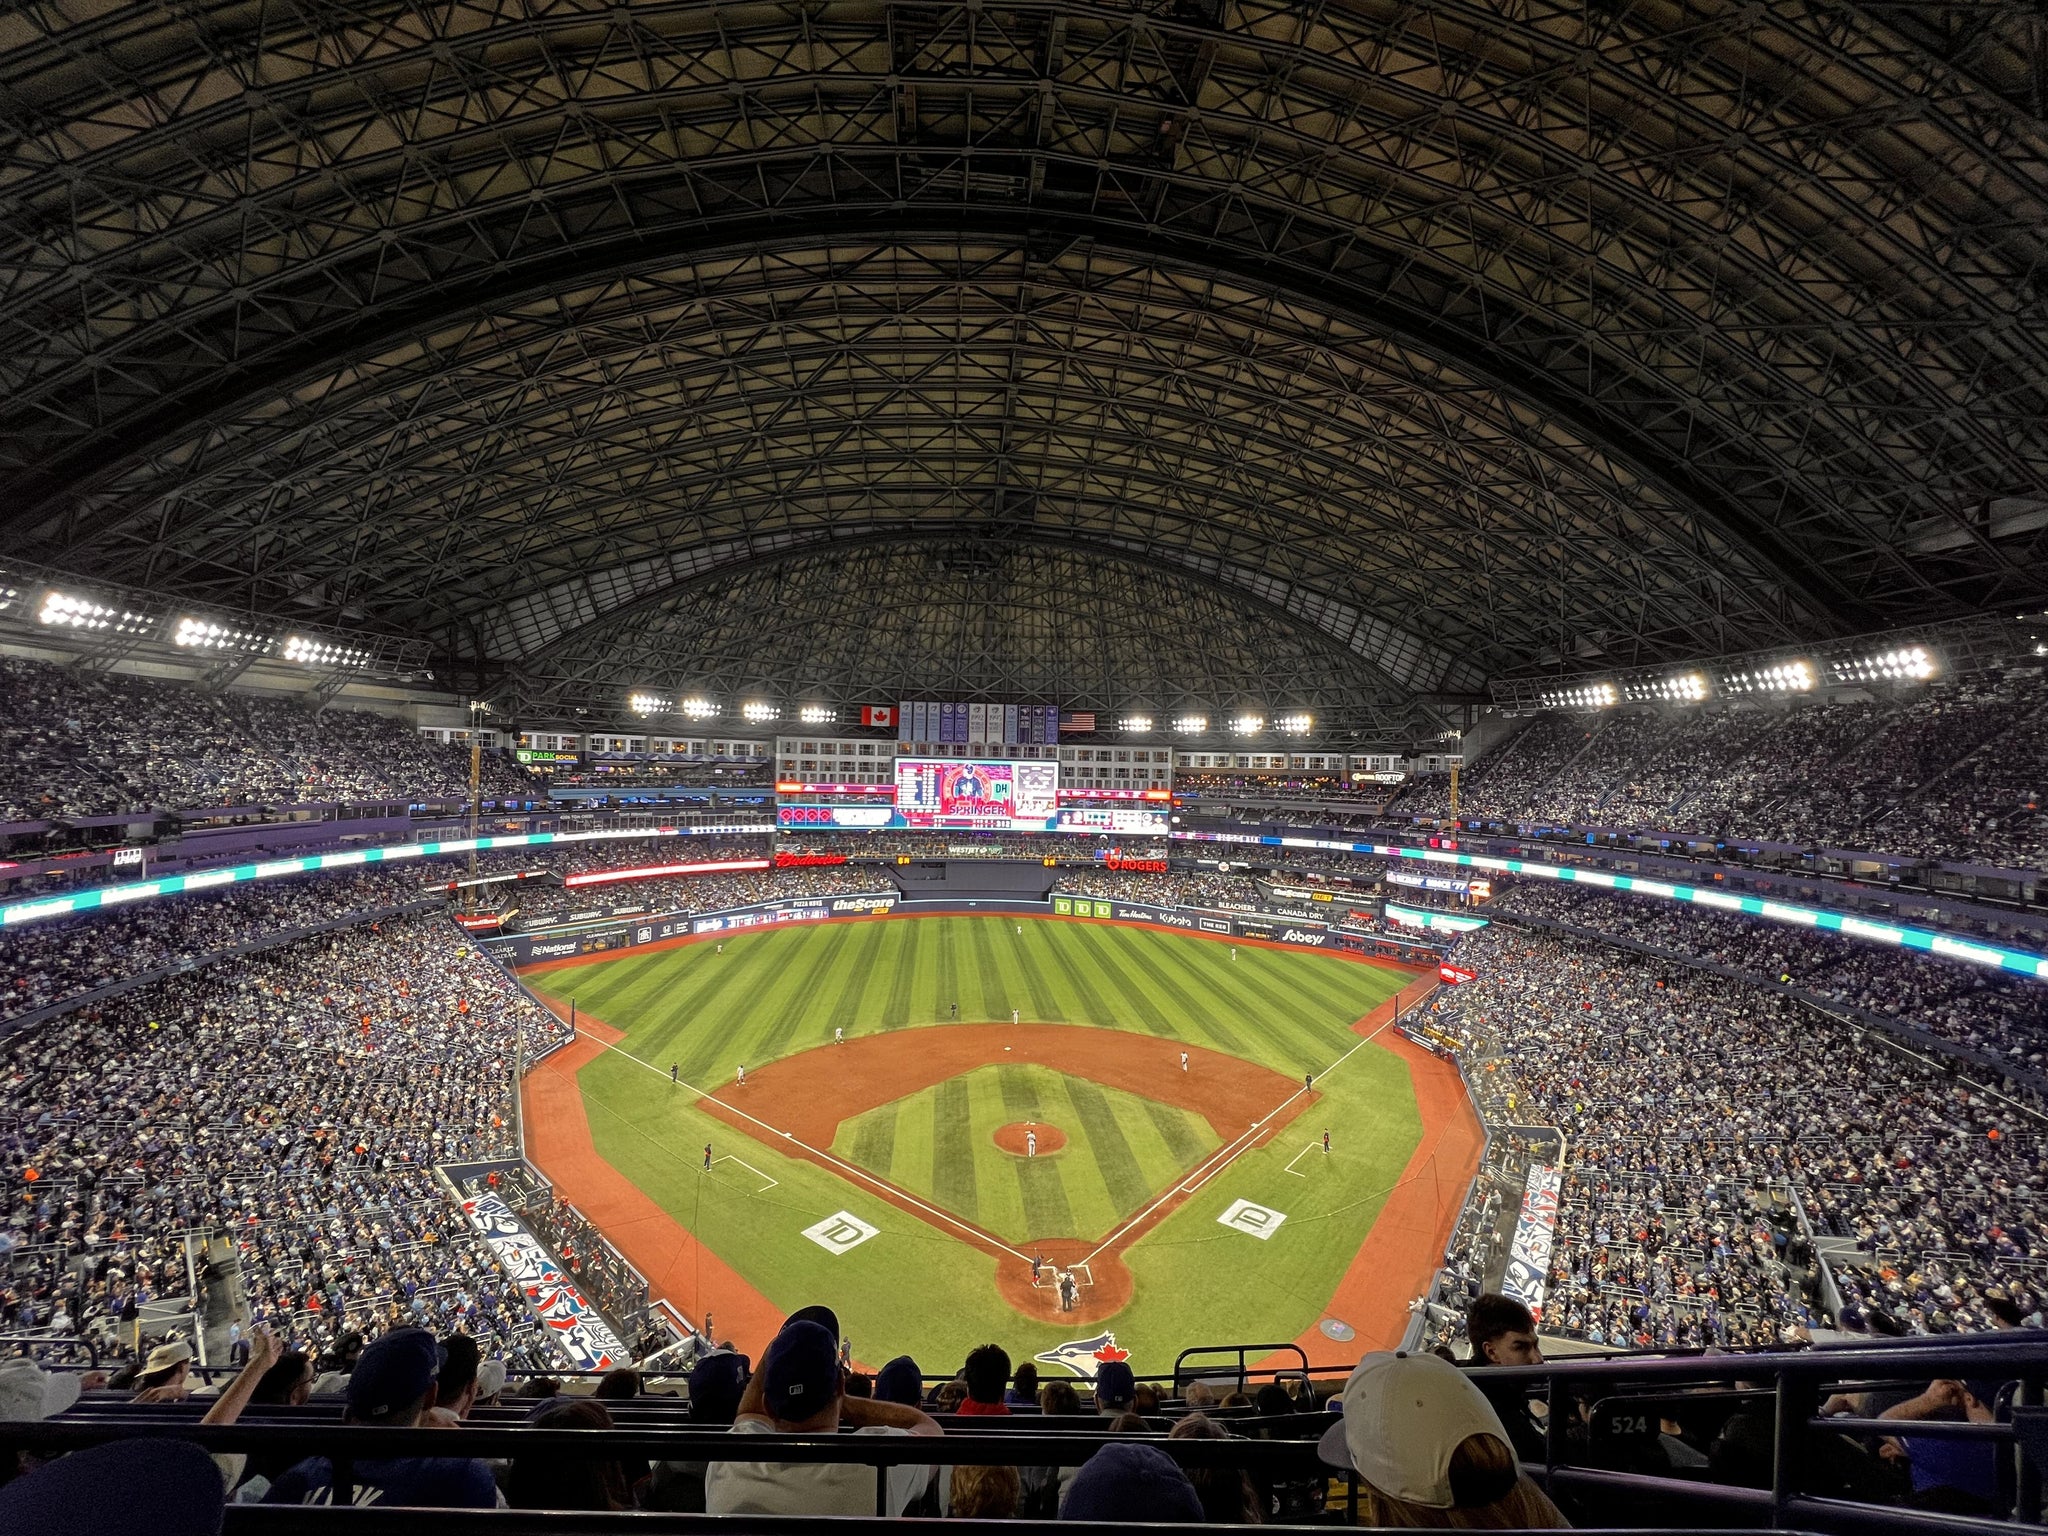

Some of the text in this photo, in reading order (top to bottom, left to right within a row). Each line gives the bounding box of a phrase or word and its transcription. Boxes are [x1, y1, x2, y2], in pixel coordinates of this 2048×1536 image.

[518, 752, 532, 763] TD
[532, 751, 555, 760] PARK
[1375, 773, 1405, 782] ROOFTOP
[995, 783, 1008, 793] DH
[949, 805, 1005, 815] SPRINGER
[948, 846, 980, 854] WESTJET
[773, 852, 847, 867] Budweiser
[1121, 860, 1168, 872] ROGERS
[1272, 888, 1312, 899] theScore
[612, 905, 645, 915] SUBWAY
[832, 898, 895, 911] theScore
[1218, 901, 1256, 912] BLEACHERS
[568, 911, 603, 921] SUBWAY
[1118, 909, 1152, 920] Tim Hortons
[1159, 912, 1192, 927] Kubota
[1277, 908, 1324, 920] CANADA DRY
[1282, 928, 1326, 946] Sobeys
[541, 941, 577, 954] National
[1229, 1206, 1273, 1229] TD
[820, 1217, 864, 1245] TD
[1611, 1416, 1648, 1434] 524
